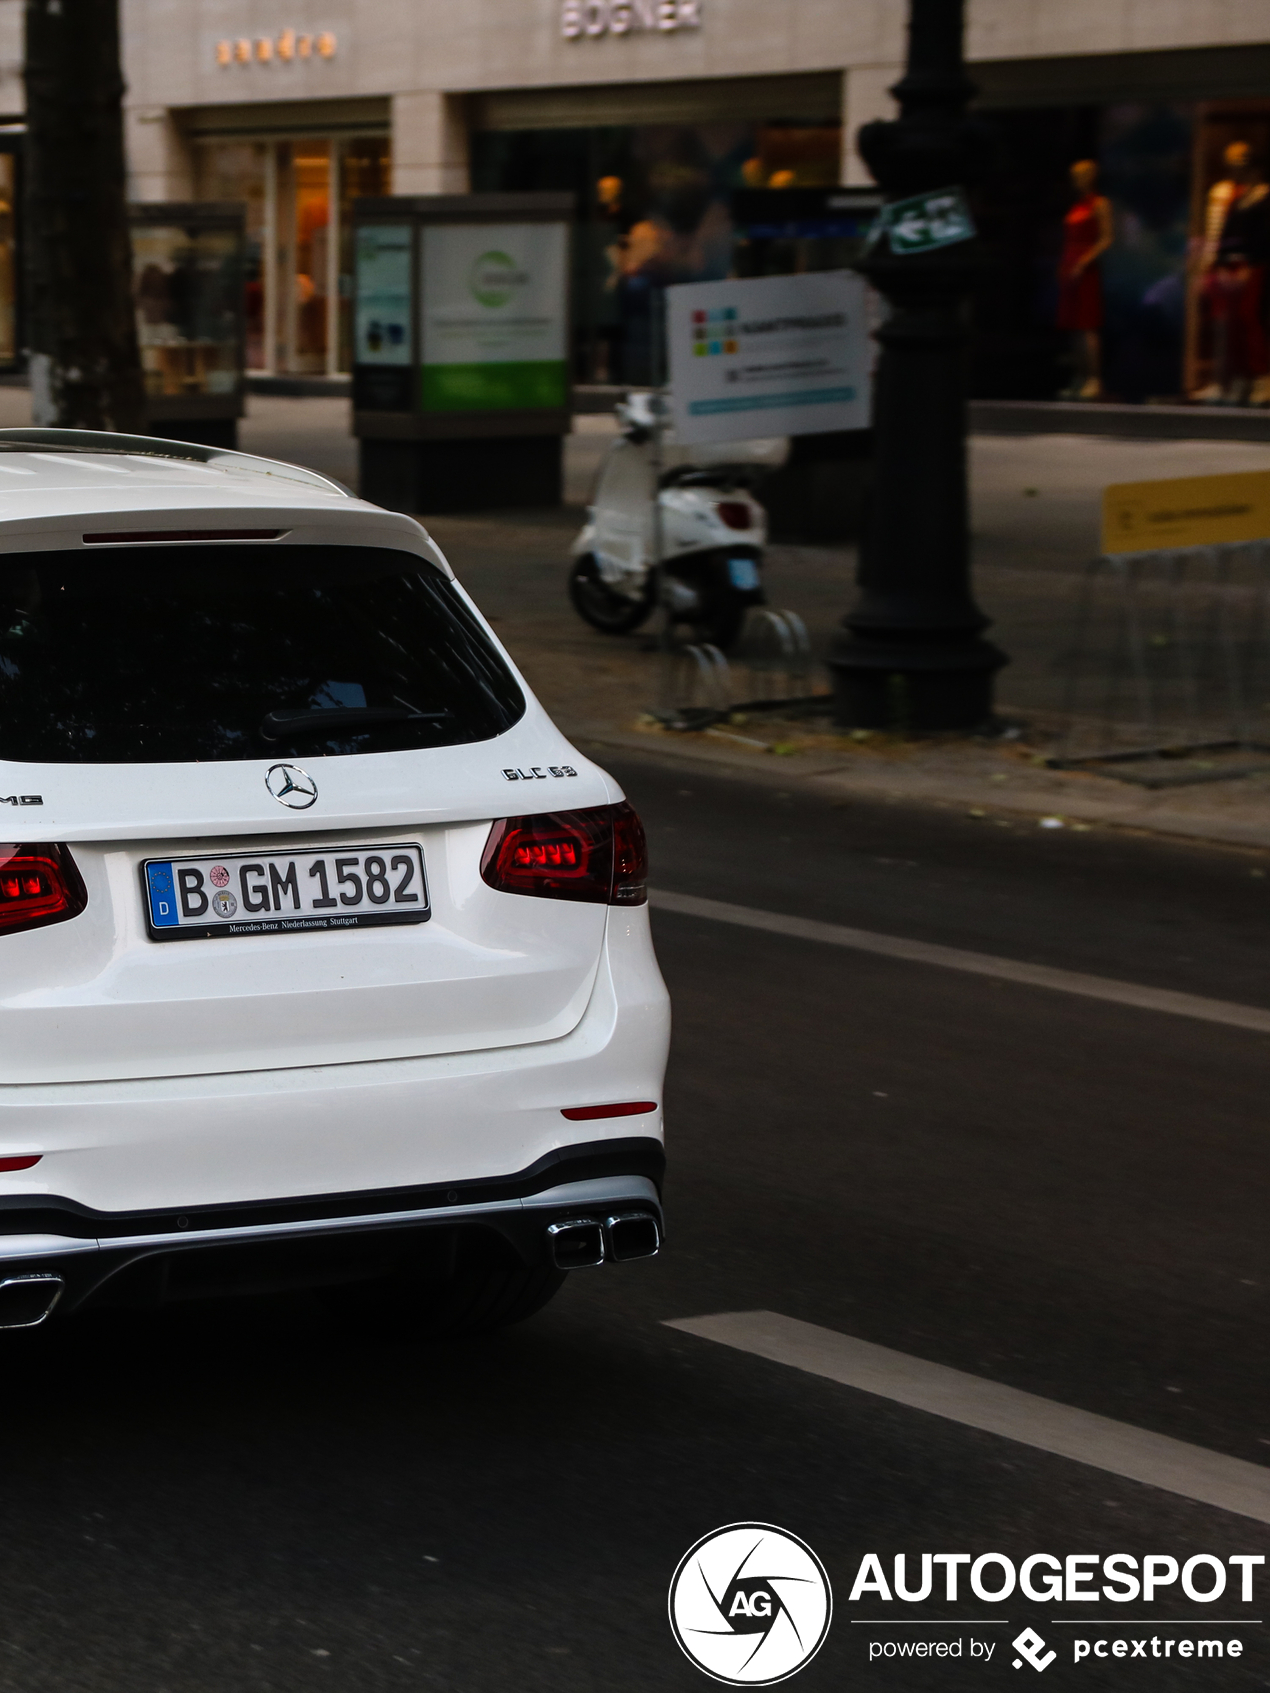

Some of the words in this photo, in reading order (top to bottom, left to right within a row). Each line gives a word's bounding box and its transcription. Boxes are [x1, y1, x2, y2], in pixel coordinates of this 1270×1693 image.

[561, 0, 702, 38] BOGNER
[500, 767, 547, 781] GLC
[547, 765, 578, 778] 63
[159, 901, 170, 916] D
[177, 868, 209, 917] B
[239, 861, 301, 913] GM
[307, 855, 419, 909] 1582
[229, 922, 279, 933] Mercedes-Benz
[281, 918, 328, 930] Niederlassung
[330, 916, 359, 926] Stuttgart
